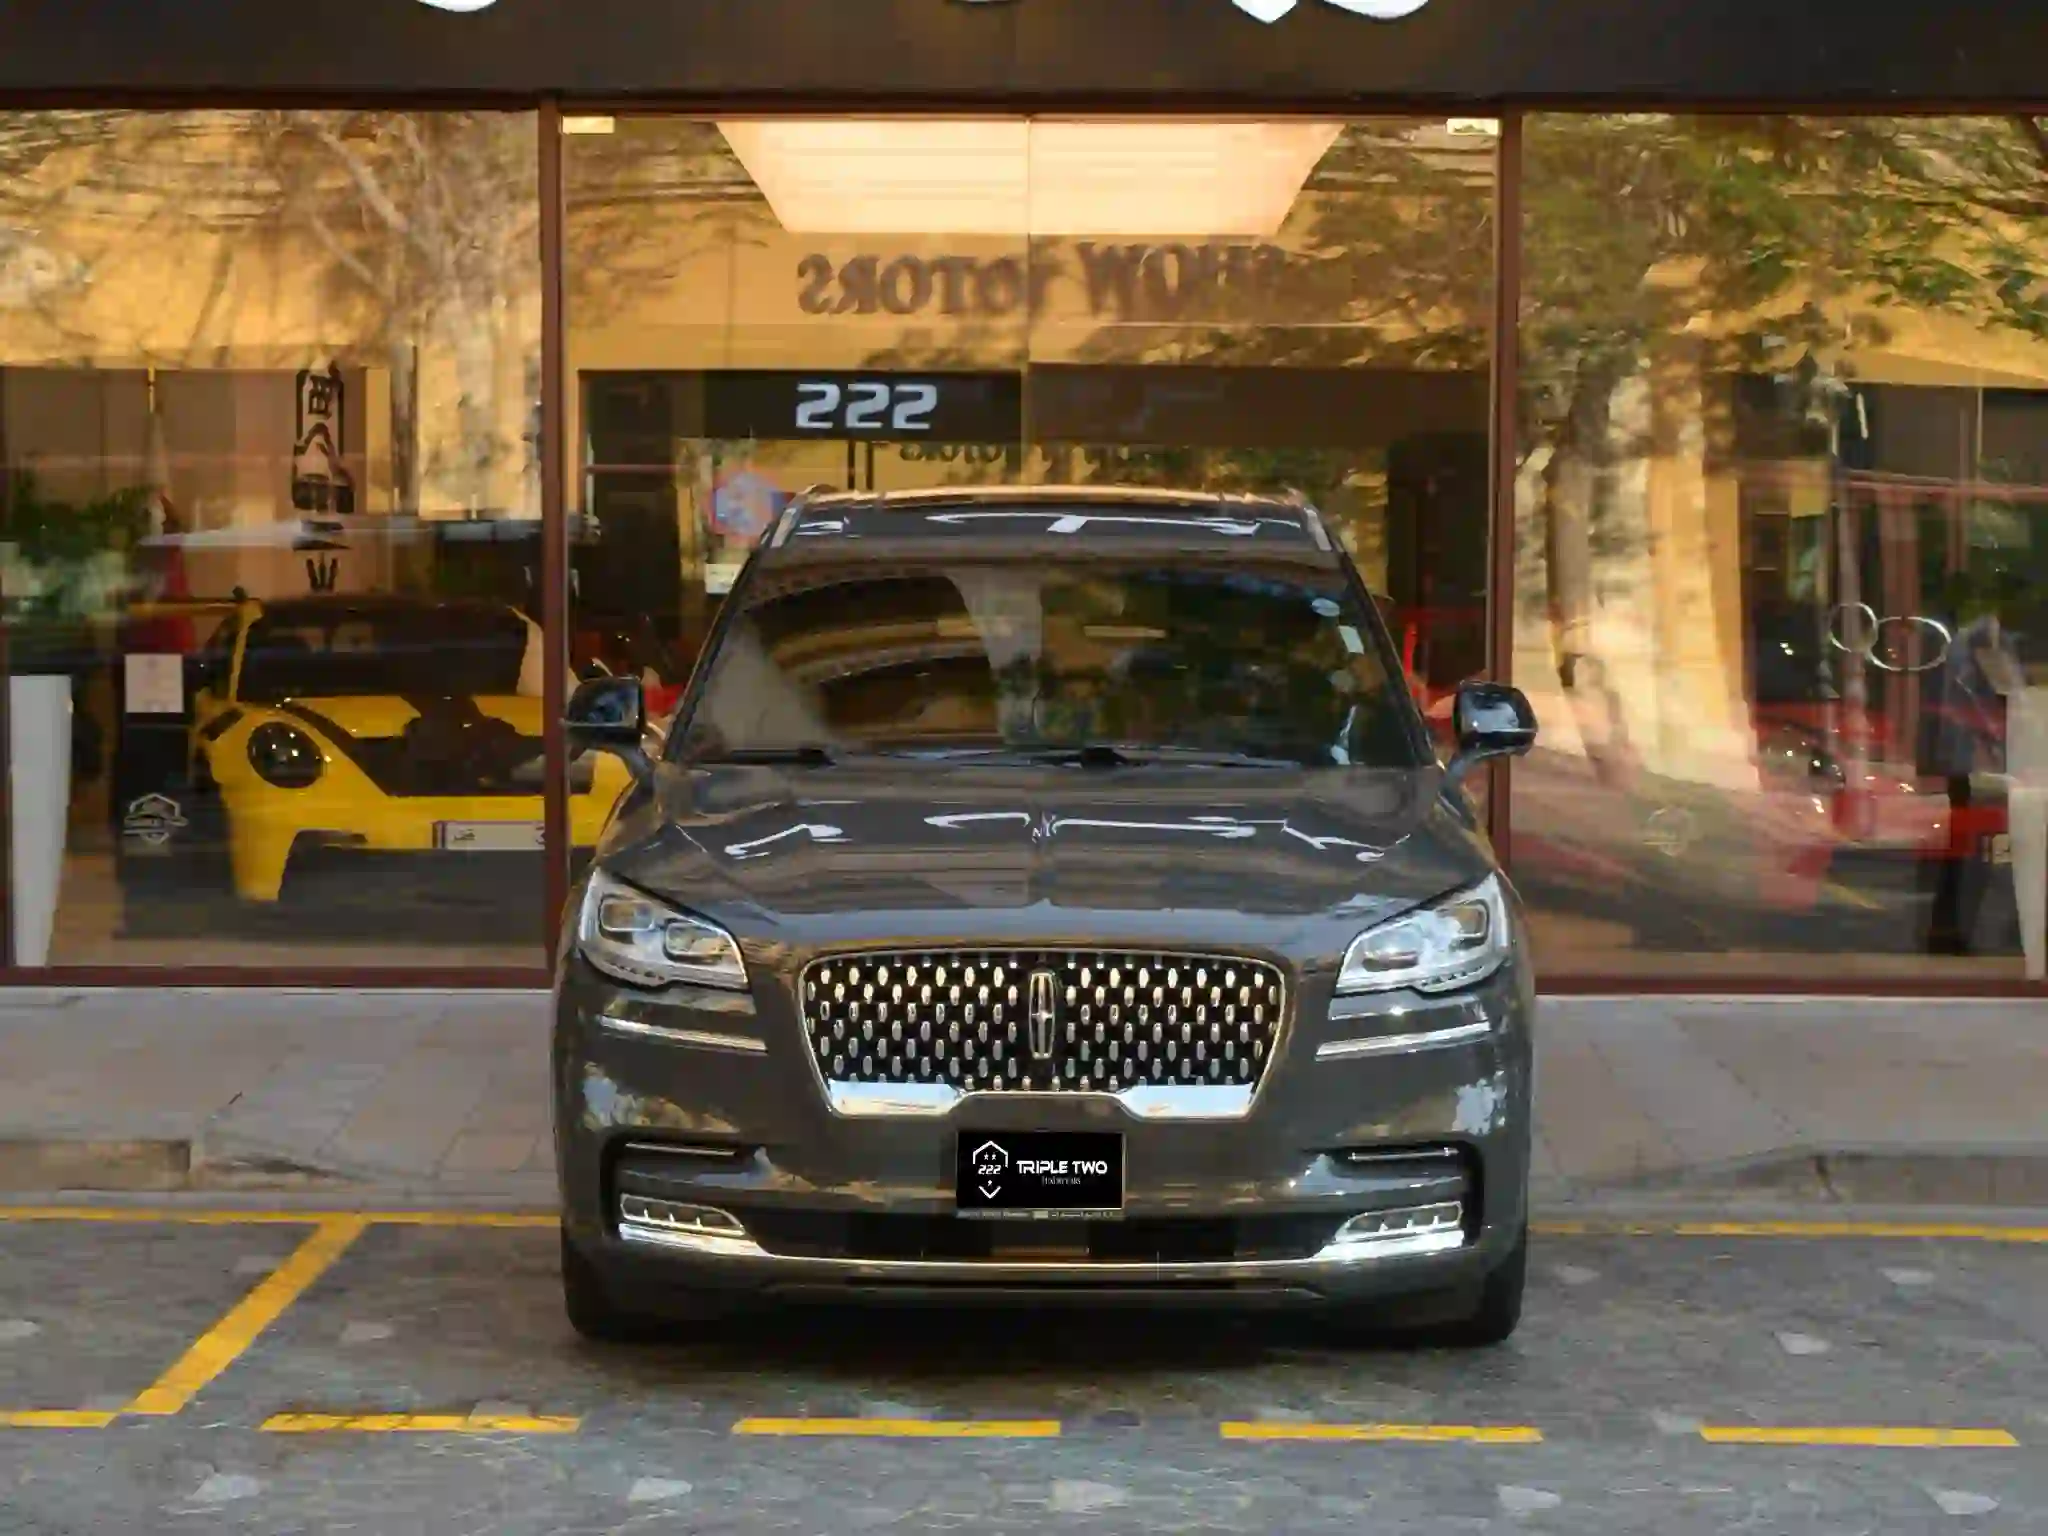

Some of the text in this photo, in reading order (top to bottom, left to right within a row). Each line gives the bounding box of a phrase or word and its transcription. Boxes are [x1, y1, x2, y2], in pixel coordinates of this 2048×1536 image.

[795, 383, 938, 429] 222
[978, 1164, 1002, 1175] 222
[1016, 1160, 1108, 1175] TRIPLE TWO
